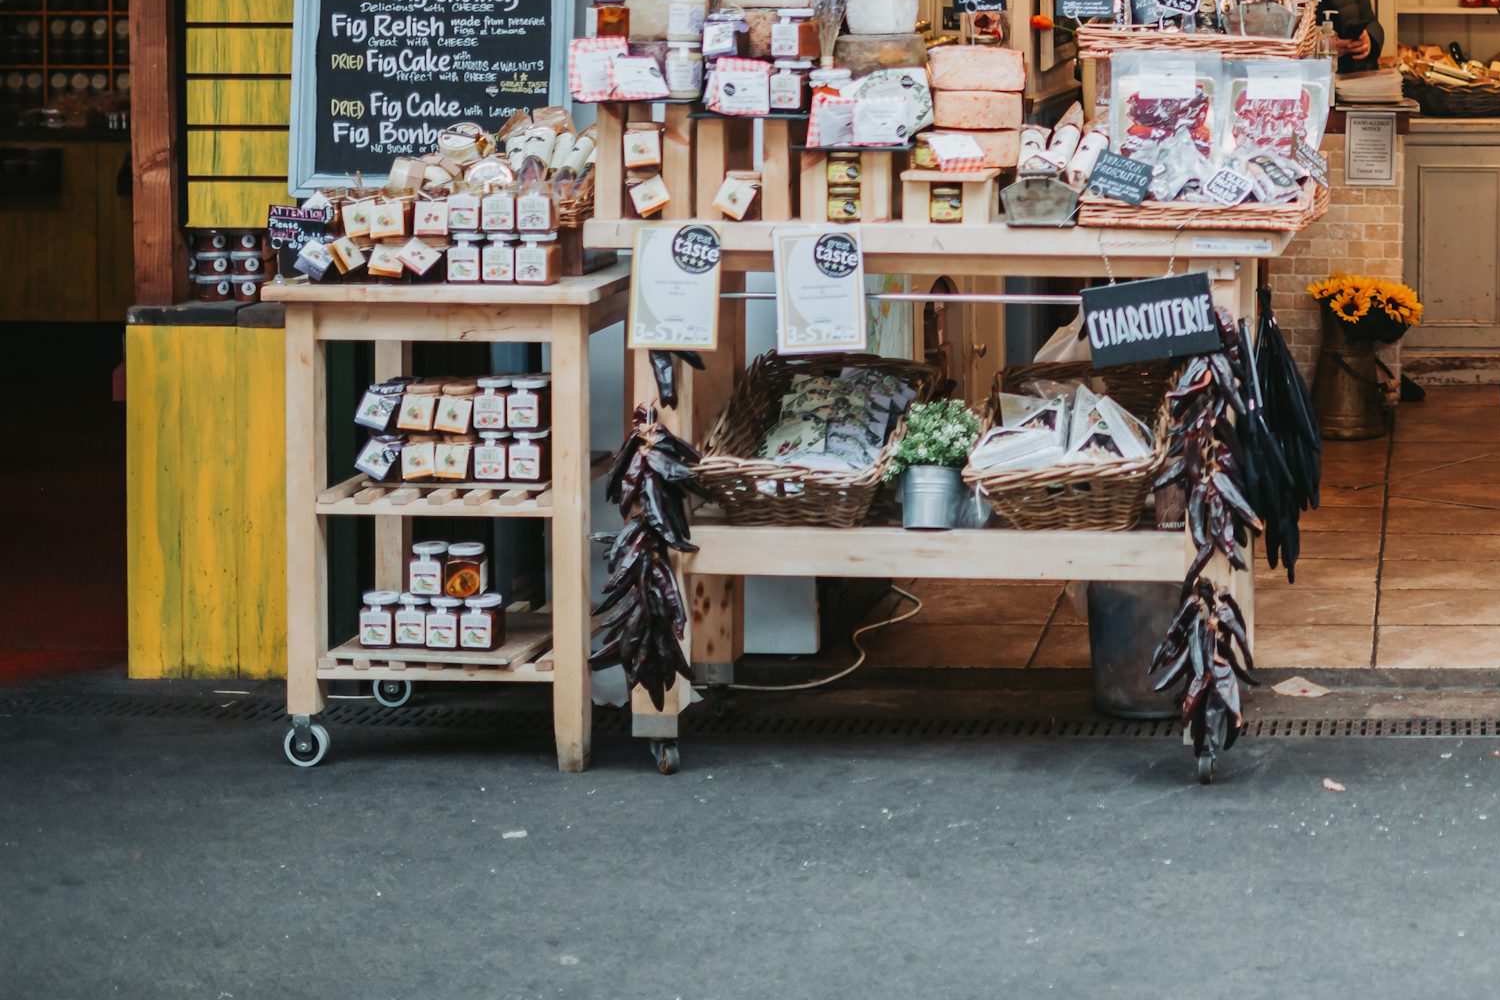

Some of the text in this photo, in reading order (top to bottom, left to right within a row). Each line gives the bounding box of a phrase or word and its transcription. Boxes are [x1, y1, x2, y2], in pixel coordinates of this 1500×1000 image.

[360, 2, 495, 13] Delicious with CHEESE
[331, 14, 444, 42] Fig Relish
[330, 48, 451, 76] DRIED Fig Cake
[330, 92, 462, 122] DRIED Fig Cake
[674, 237, 720, 262] taste
[687, 232, 713, 245] great
[827, 240, 850, 250] great
[816, 245, 858, 267] taste
[1087, 294, 1215, 349] CHARCUTERIE
